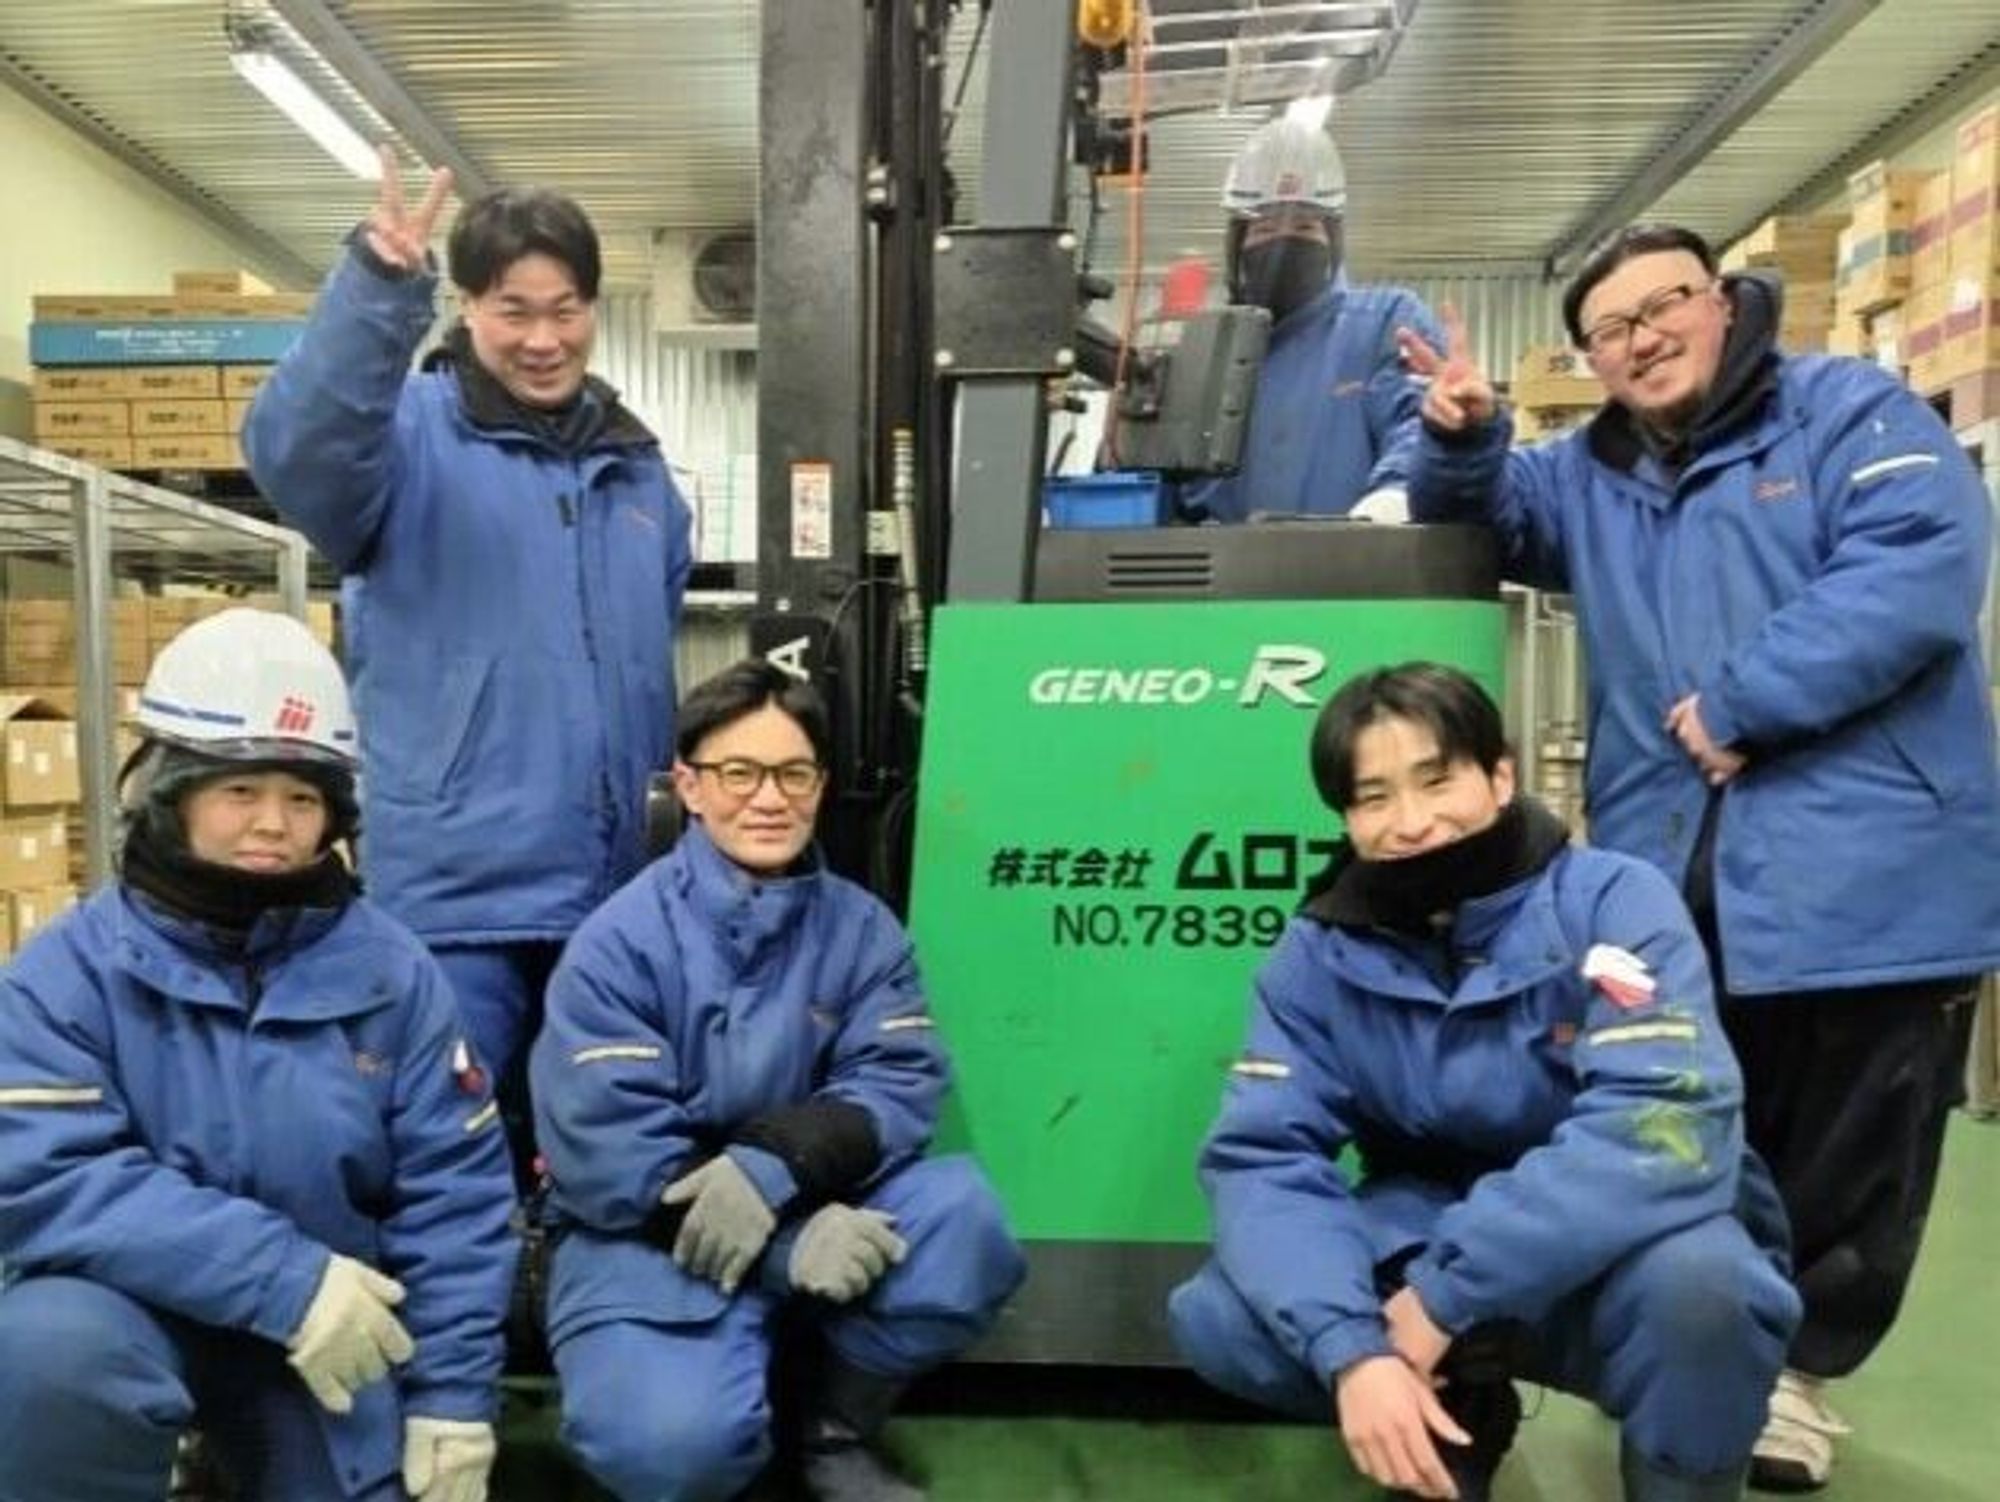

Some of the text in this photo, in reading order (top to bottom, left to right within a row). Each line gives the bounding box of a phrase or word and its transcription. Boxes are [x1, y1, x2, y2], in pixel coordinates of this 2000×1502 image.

[1029, 644, 1326, 708] GENEO-R
[988, 848, 1152, 888] 株式会社
